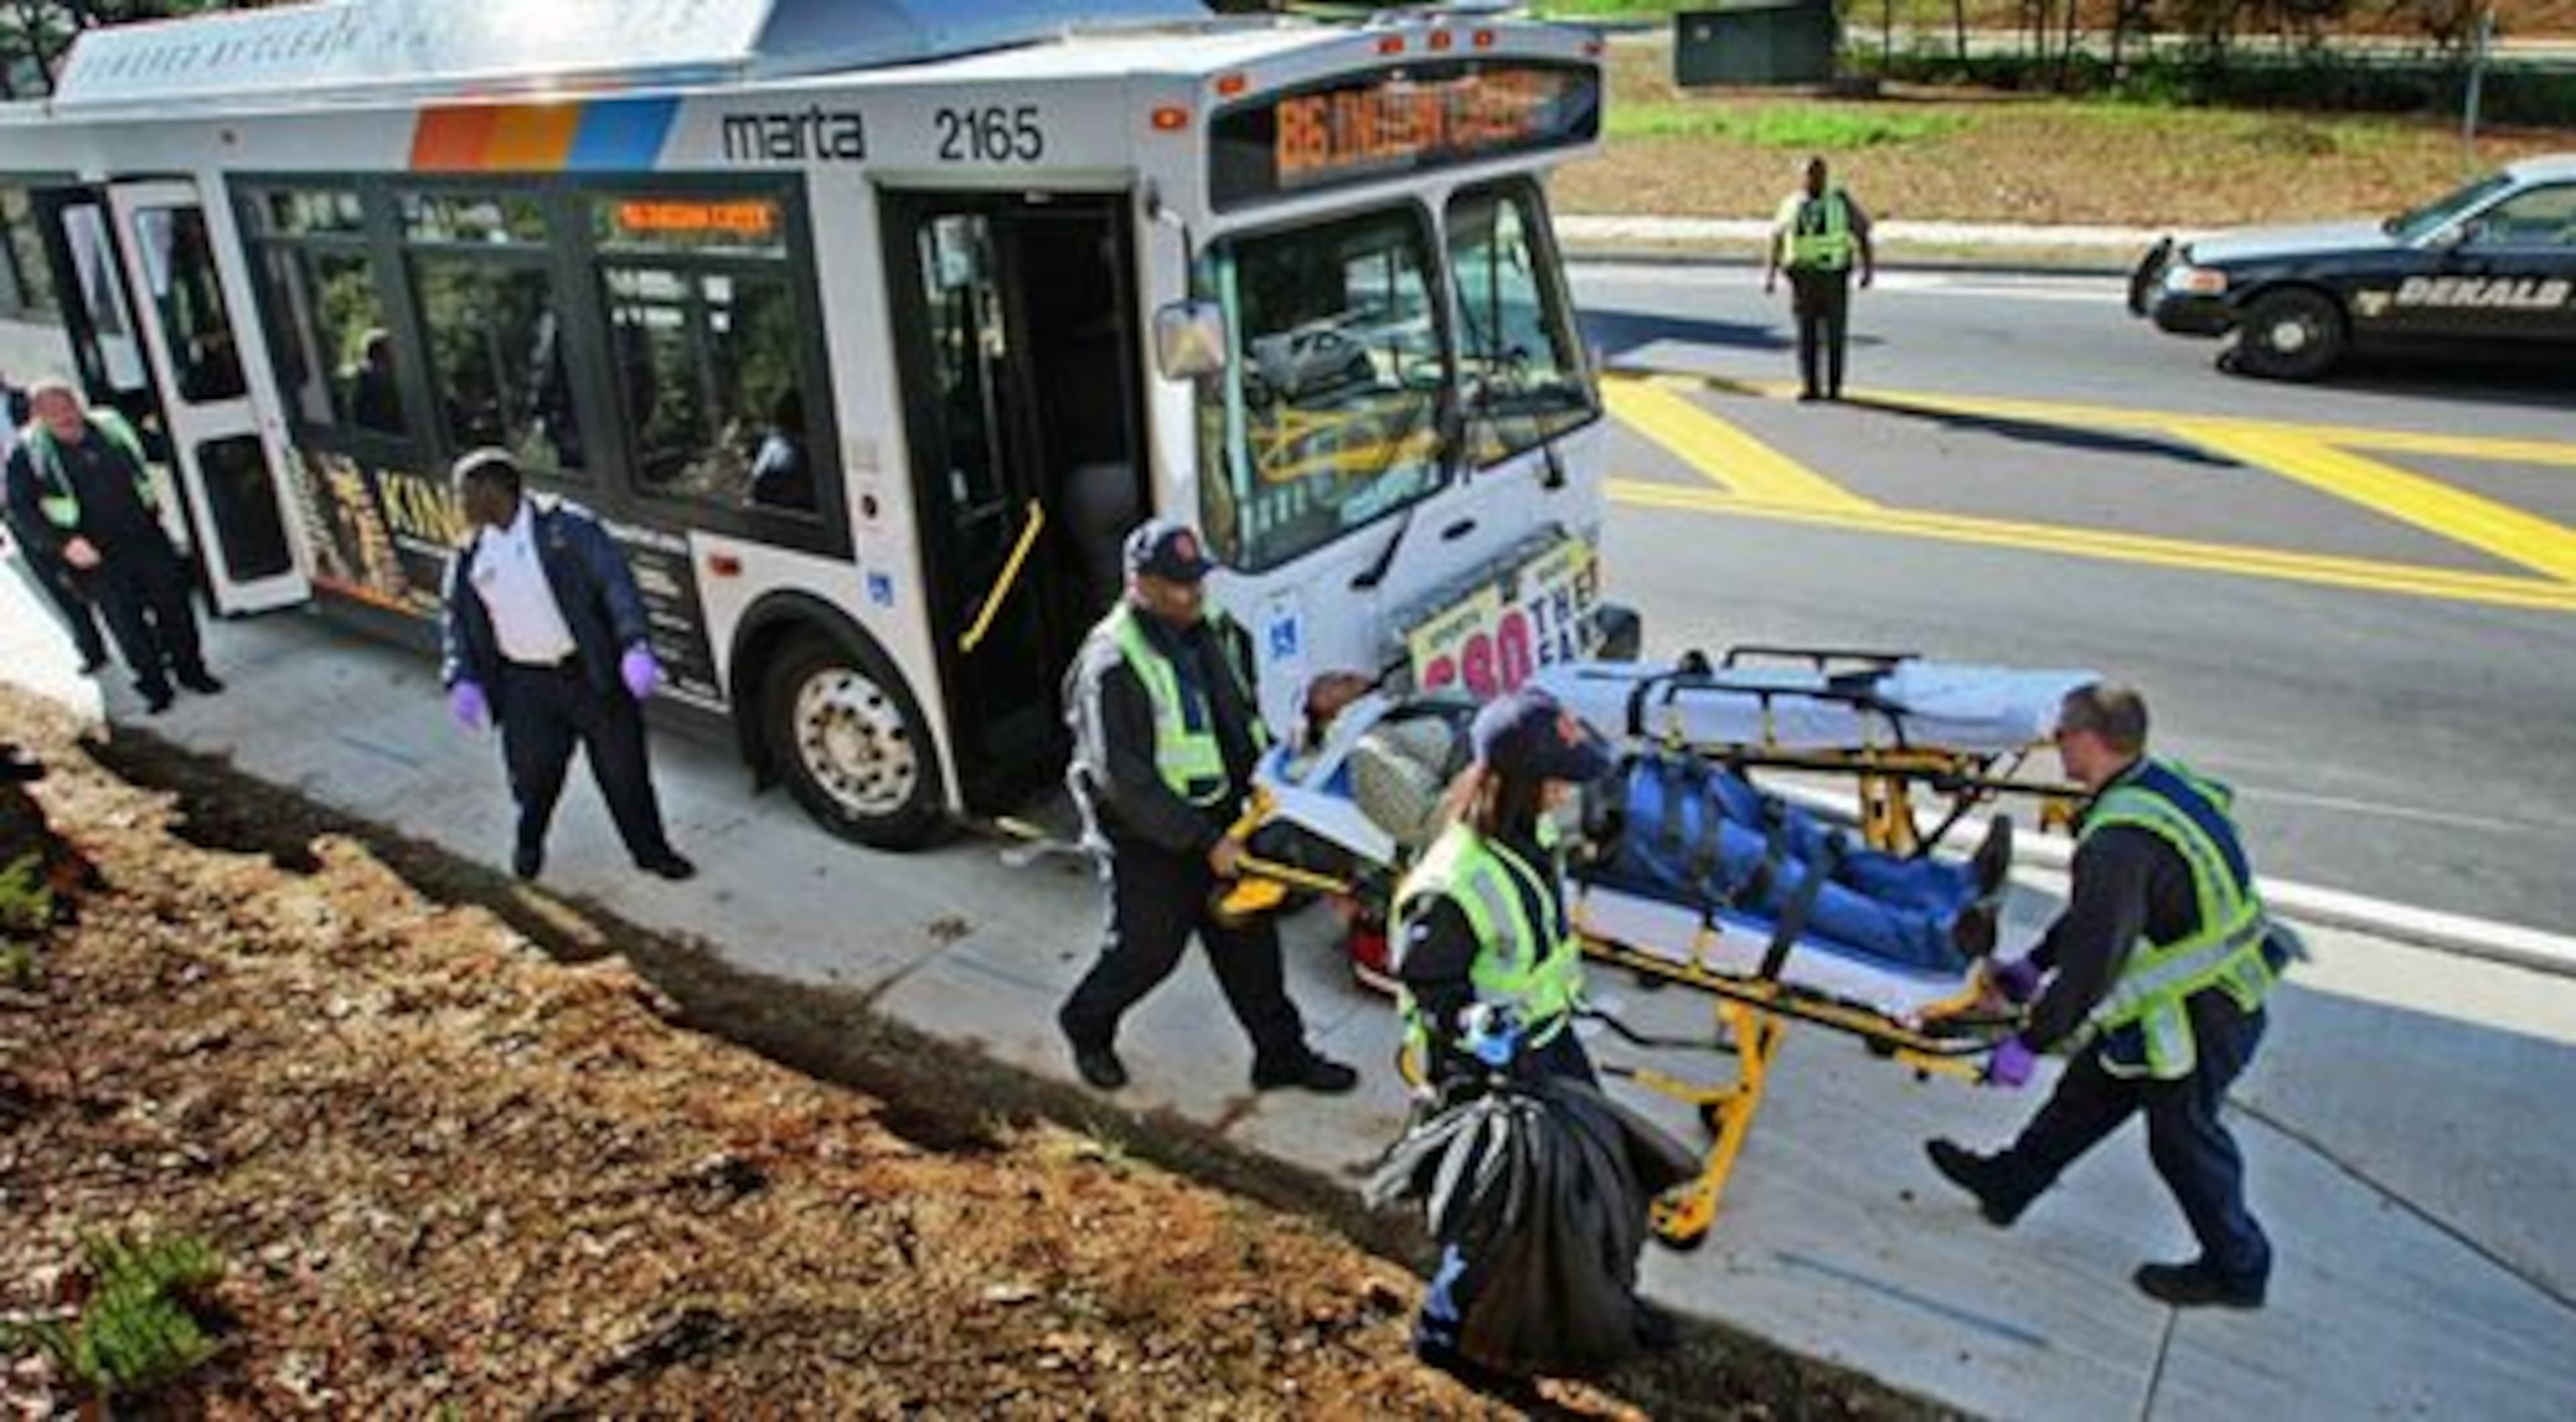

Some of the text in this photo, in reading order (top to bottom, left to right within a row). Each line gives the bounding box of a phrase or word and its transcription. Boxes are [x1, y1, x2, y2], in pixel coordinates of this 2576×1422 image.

[723, 103, 1044, 161] marta 2165
[2394, 276, 2572, 309] DEKALB
